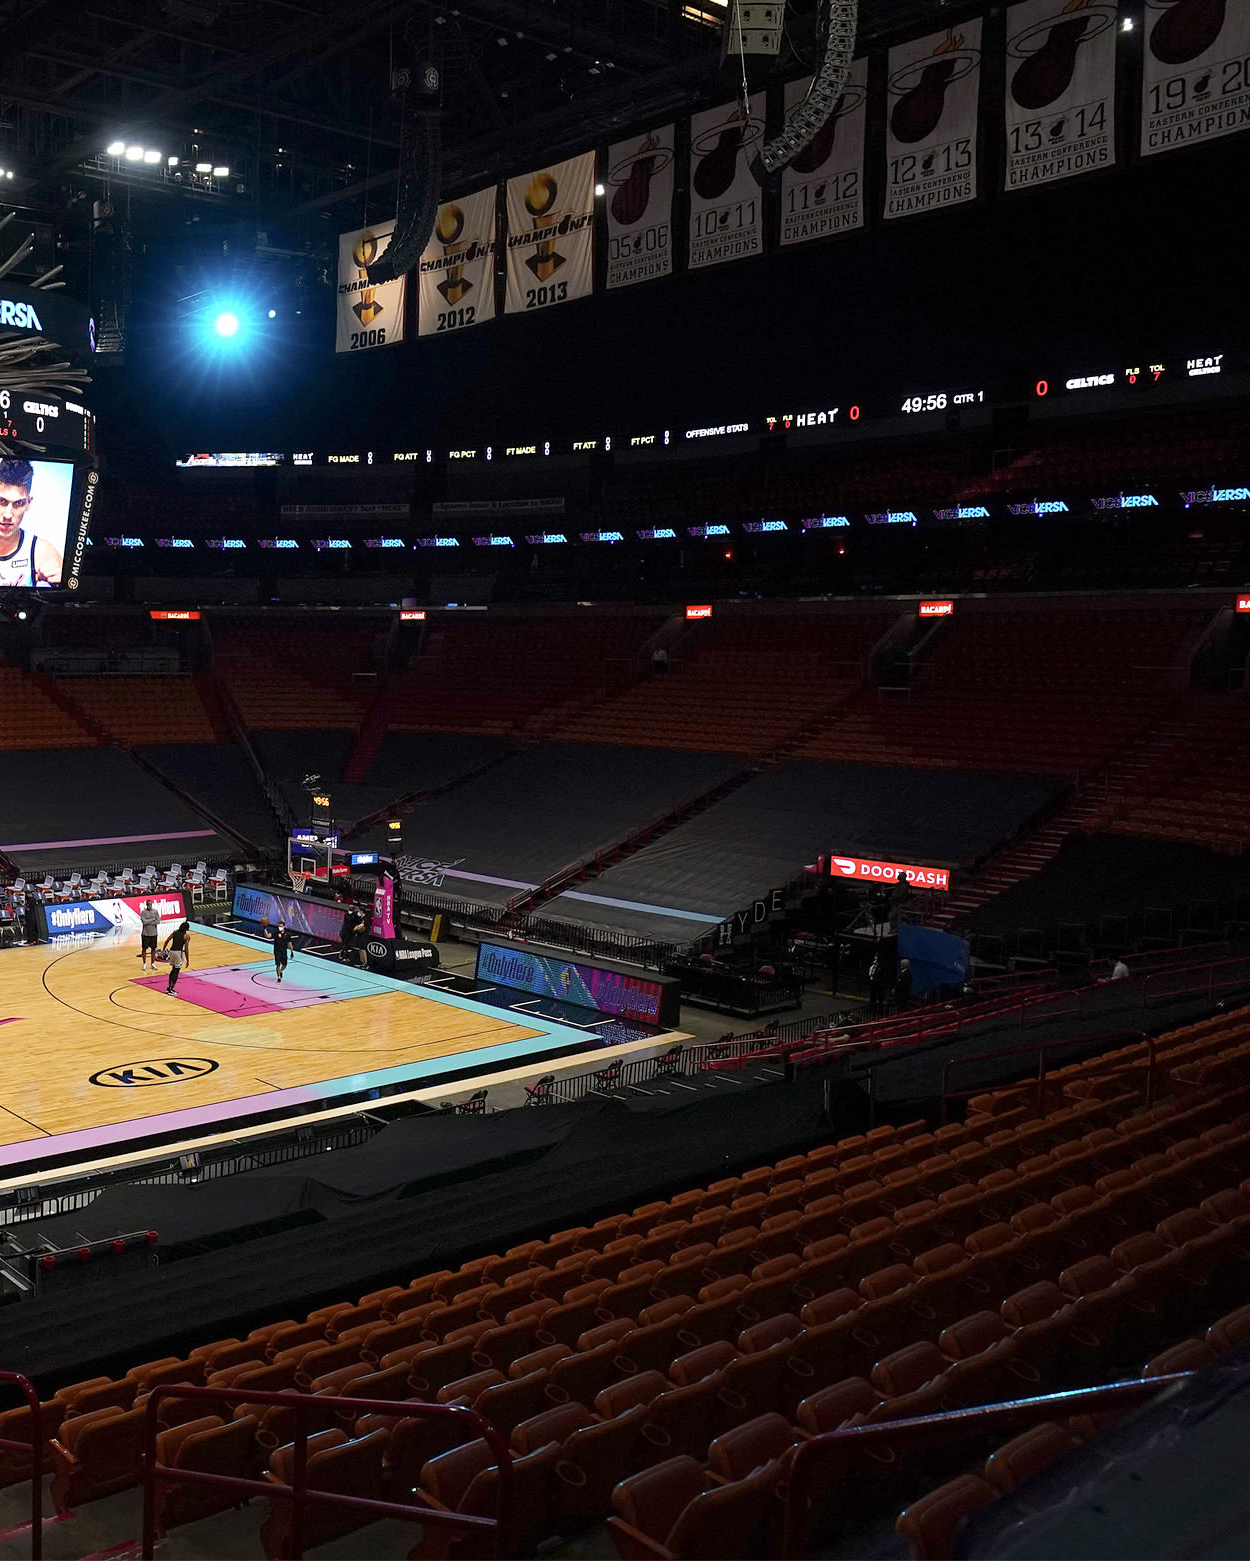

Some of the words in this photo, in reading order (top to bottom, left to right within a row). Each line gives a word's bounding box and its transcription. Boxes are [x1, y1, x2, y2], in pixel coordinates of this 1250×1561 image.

[1150, 78, 1186, 115] 19
[1150, 110, 1195, 129] EASTERN
[1198, 93, 1250, 115] CONFEREN
[1011, 122, 1042, 154] 13
[1075, 103, 1106, 136] 14
[1149, 107, 1250, 147] CHAMPION
[891, 156, 916, 185] 12
[943, 139, 971, 171] 13
[1010, 152, 1048, 167] EASTERN
[1051, 135, 1108, 159] CONFERENCE
[1010, 149, 1108, 184] CHAMPIONS
[789, 185, 810, 212] 11
[832, 172, 858, 200] 12
[890, 183, 921, 196] EASTERN
[923, 170, 971, 190] CONFERENCE
[889, 183, 971, 213] CHAMPIONS
[696, 211, 717, 238] 10
[735, 201, 755, 227] 11
[784, 212, 858, 239] CHAMPIONS
[610, 235, 630, 260] 05
[646, 225, 668, 251] 06
[692, 237, 758, 263] CHAMPIONS
[610, 260, 669, 284] CHAMPIONS
[526, 281, 568, 308] 2013
[437, 306, 475, 330] 2012
[351, 328, 386, 349] 2006
[1126, 367, 1140, 376] FLS
[1150, 364, 1165, 372] TOL
[1187, 354, 1223, 369] HEAT
[1036, 380, 1048, 396] 0
[1066, 374, 1114, 390] CELTICS
[1129, 375, 1136, 384] 0
[1153, 372, 1160, 381] 7
[23, 401, 59, 418] CELTICS
[901, 393, 947, 413] 49:56
[953, 393, 974, 404] QTR
[978, 391, 984, 402] 1
[36, 417, 44, 432] 0
[796, 408, 838, 427] HEAT
[850, 406, 859, 420] 0
[641, 436, 655, 444] PCT
[686, 427, 725, 439] OFFENSIVE
[726, 423, 748, 434] STATS
[506, 447, 515, 455] FT
[516, 446, 536, 455] MADE
[582, 441, 596, 449] ATT
[339, 455, 359, 463] MADE
[72, 485, 95, 576] MICCOSUKEE.COM
[236, 893, 272, 915] #OnlyHere
[51, 907, 94, 928] #OnlyHere
[370, 945, 384, 955] KIA
[421, 948, 433, 958] Pass
[482, 953, 534, 983] #OnlyHere
[105, 1061, 206, 1085] KIA
